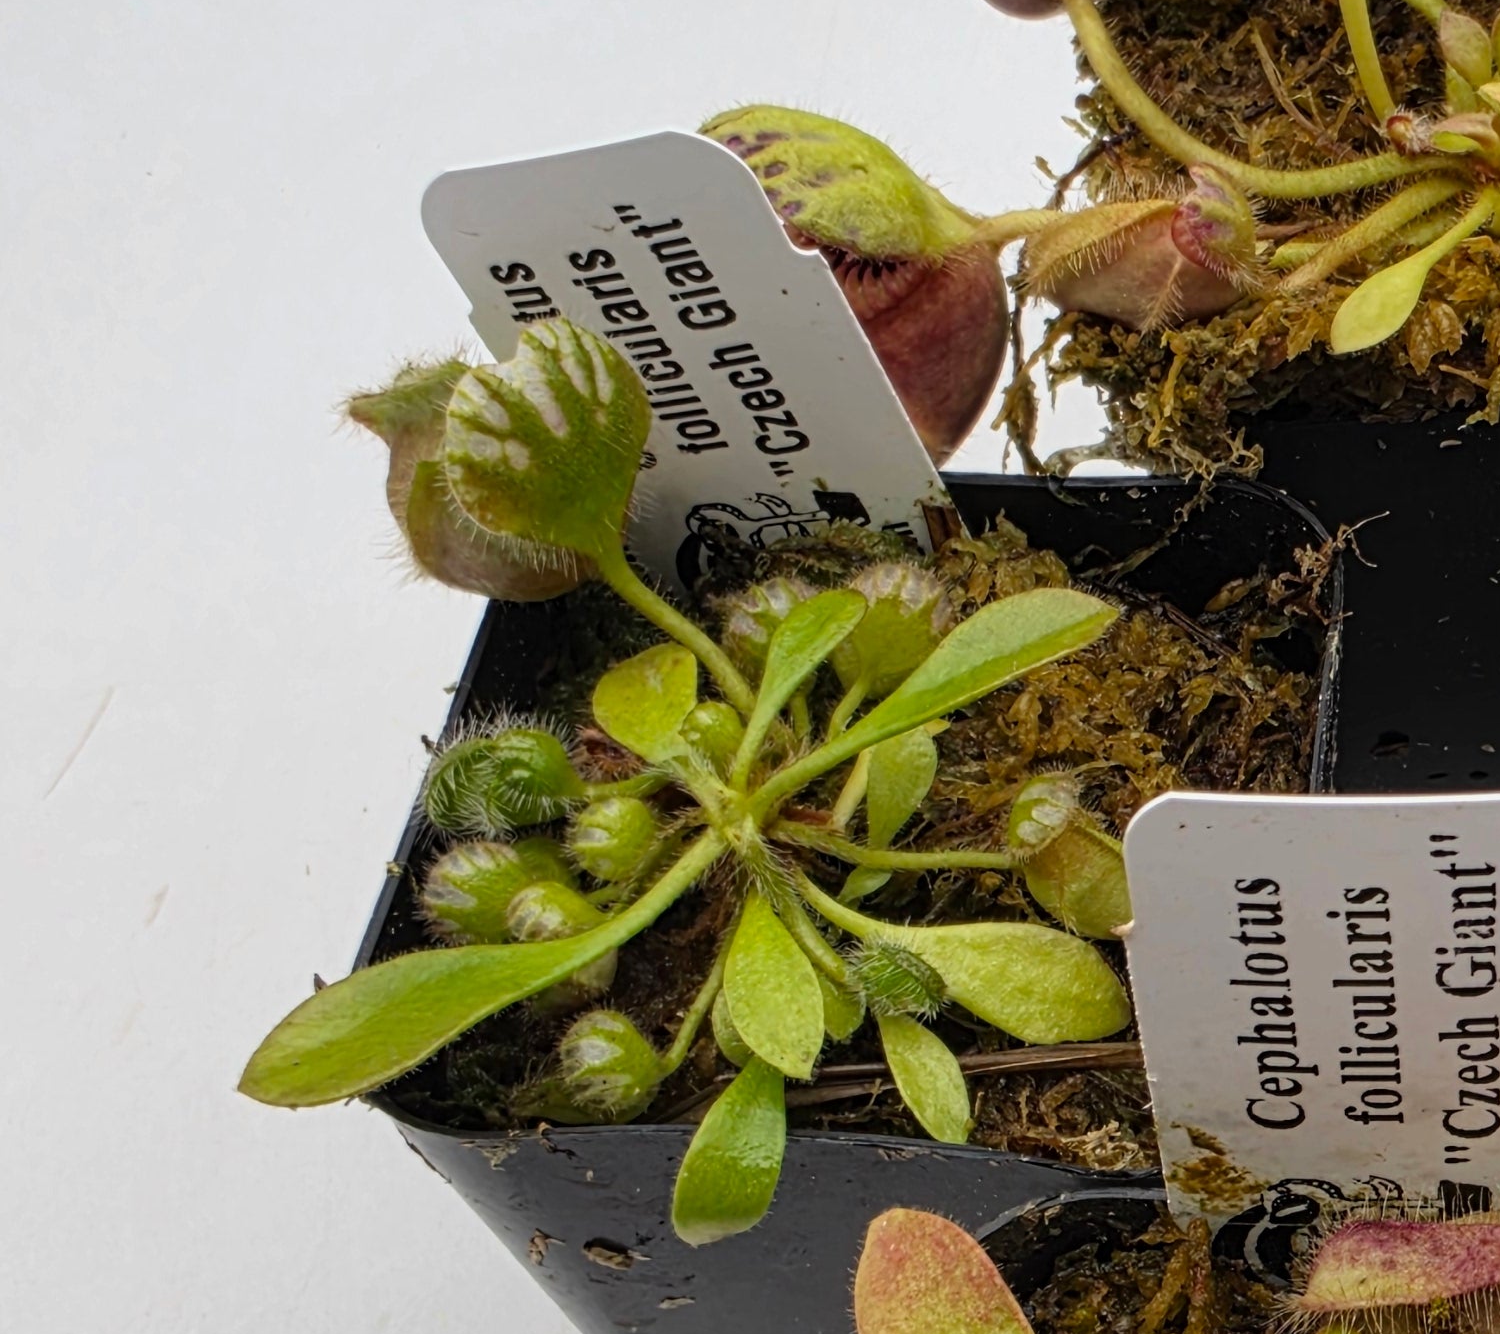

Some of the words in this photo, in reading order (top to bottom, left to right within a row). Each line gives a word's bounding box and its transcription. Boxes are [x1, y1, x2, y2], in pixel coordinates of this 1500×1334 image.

[613, 205, 736, 330] Giant"
[568, 248, 729, 455] follicularis
[709, 343, 810, 477] "Czech
[1429, 834, 1498, 997] Giant"
[1230, 877, 1319, 1129] Cephalotus
[1326, 886, 1404, 1125] follicularis
[1439, 1015, 1500, 1164] "Czech
